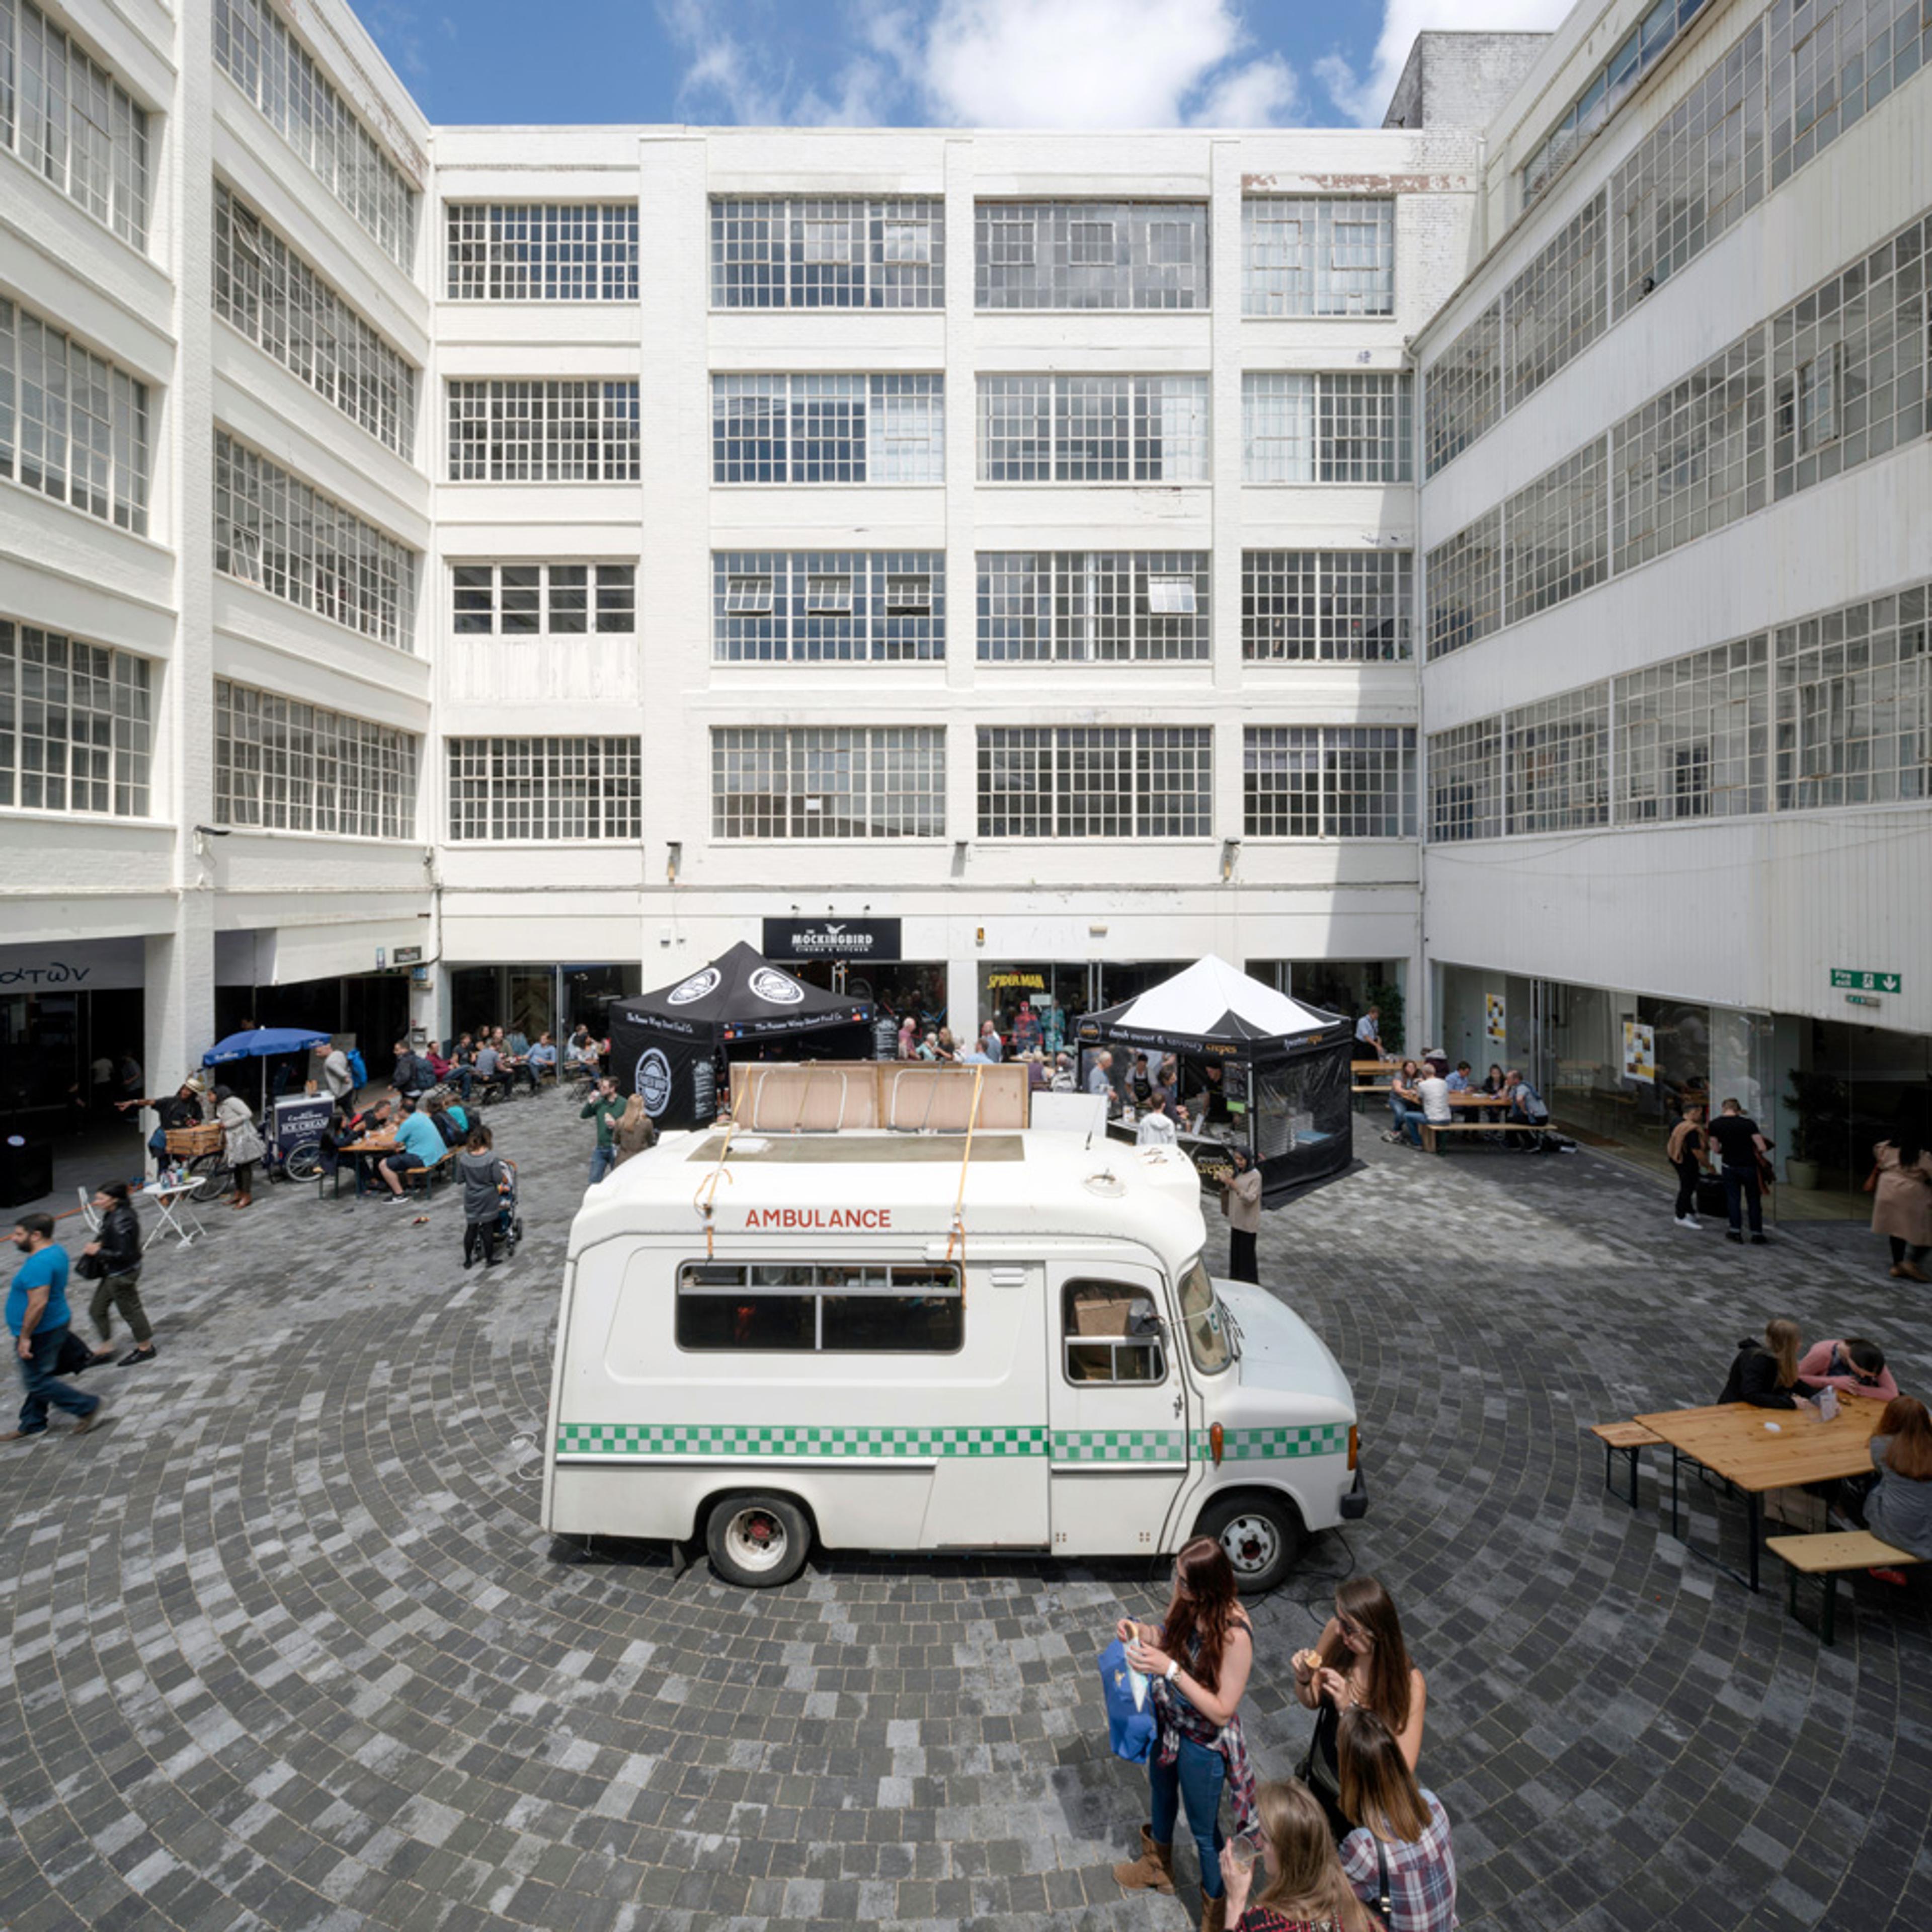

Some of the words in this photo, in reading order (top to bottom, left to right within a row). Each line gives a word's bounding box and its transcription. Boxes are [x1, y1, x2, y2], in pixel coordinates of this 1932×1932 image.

[792, 934, 873, 944] MOCKINGBIRD
[1109, 1029, 1129, 1039] fresh
[746, 1209, 891, 1228] AMBULANCE
